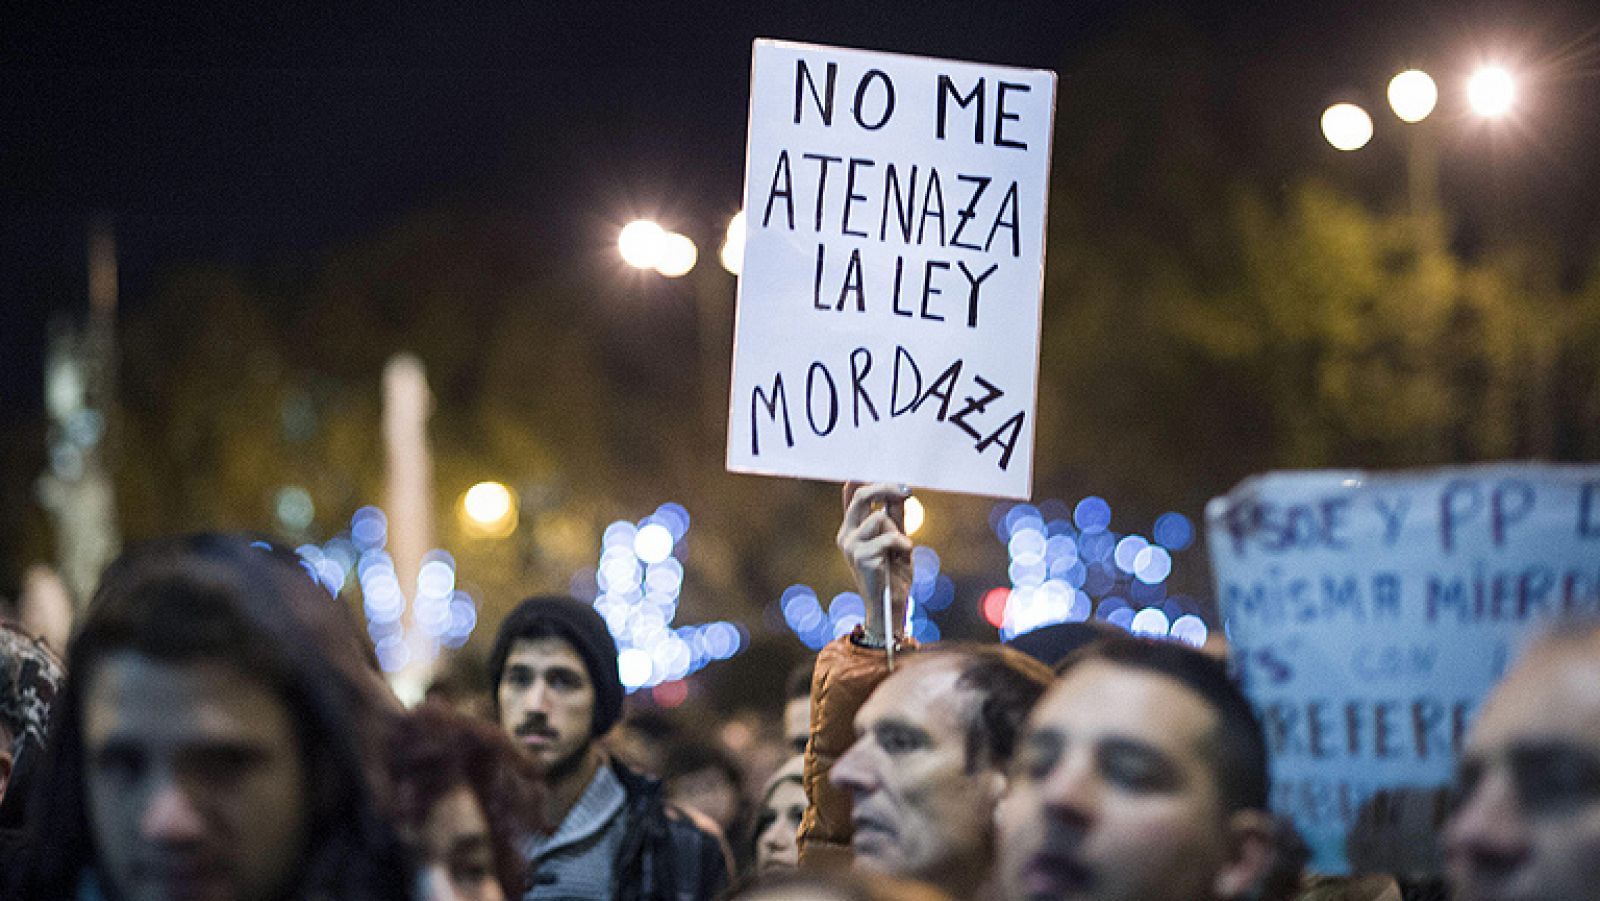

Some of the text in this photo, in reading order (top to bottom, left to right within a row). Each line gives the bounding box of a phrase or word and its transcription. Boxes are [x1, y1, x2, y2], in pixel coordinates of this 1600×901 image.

[794, 59, 1032, 151] NO ME
[762, 149, 1021, 258] ATENAZA
[813, 244, 998, 328] LA LEY
[751, 346, 1025, 470] MORDAZA
[1225, 496, 1352, 555] PSOE
[1374, 497, 1412, 546] Y
[1440, 478, 1536, 553] PP
